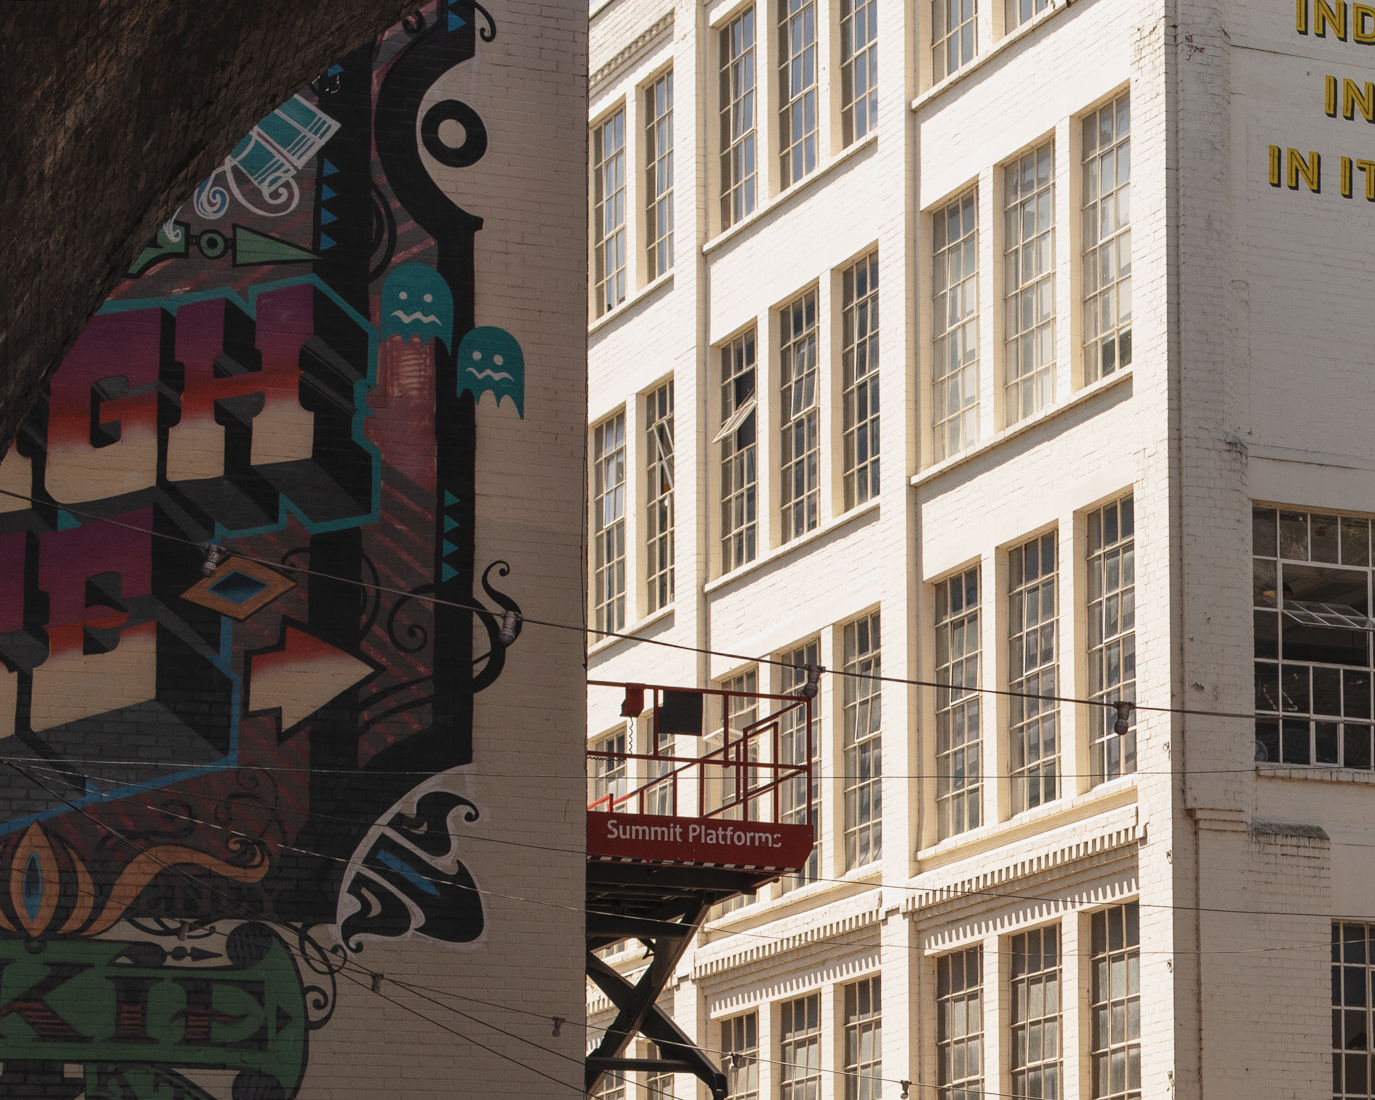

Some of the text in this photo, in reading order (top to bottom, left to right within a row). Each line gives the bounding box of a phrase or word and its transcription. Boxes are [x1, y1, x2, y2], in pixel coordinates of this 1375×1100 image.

[1269, 145, 1321, 194] IN
[607, 819, 782, 848] Summit Platforms
